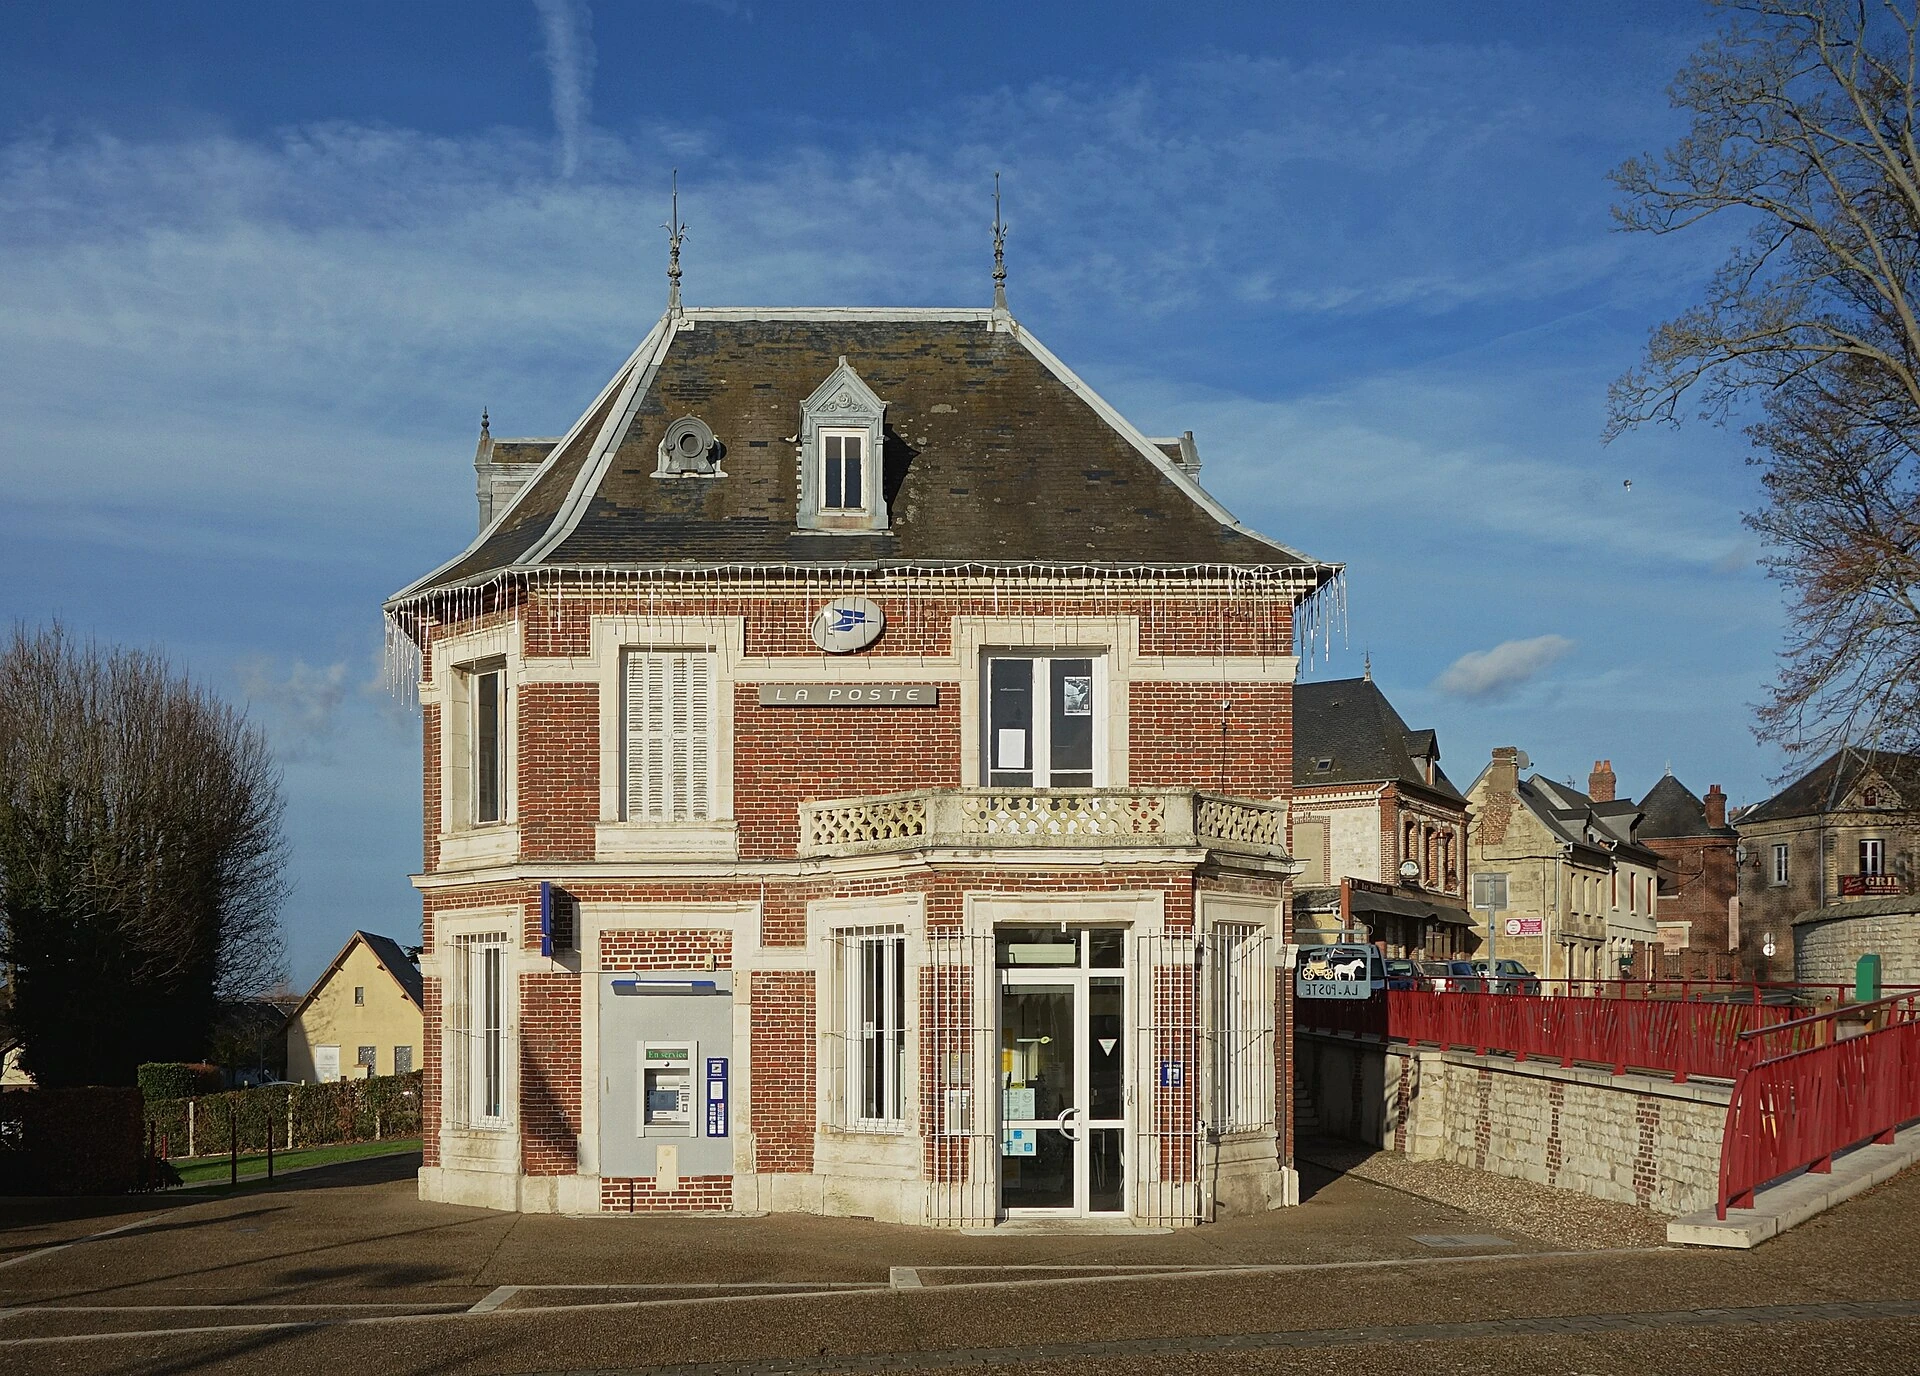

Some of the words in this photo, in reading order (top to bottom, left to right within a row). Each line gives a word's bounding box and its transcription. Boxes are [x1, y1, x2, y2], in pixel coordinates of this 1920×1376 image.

[775, 689, 809, 701] LA
[828, 689, 920, 701] POSTE
[648, 1050, 659, 1059] En
[661, 1050, 687, 1059] service
